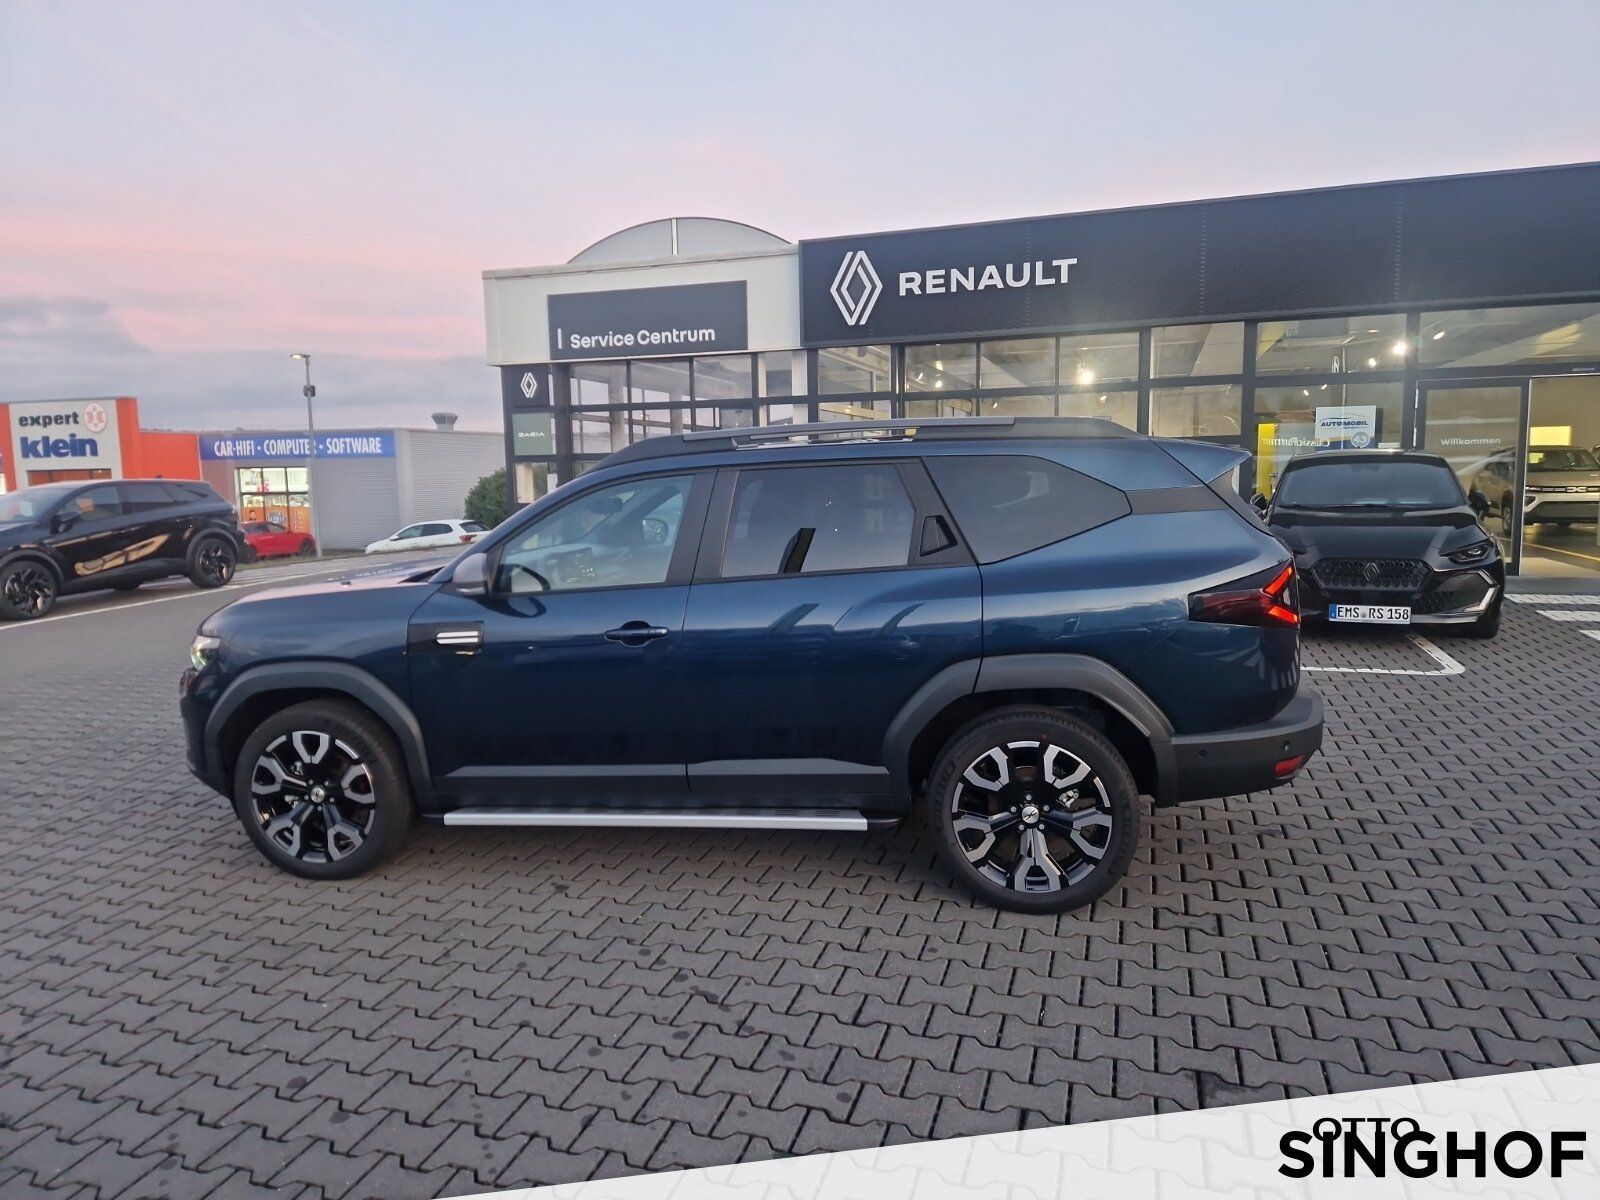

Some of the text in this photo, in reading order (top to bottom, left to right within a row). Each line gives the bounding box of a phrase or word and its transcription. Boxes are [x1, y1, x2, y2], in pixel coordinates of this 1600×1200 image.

[899, 258, 1078, 296] RENAULT
[570, 328, 715, 349] Service Centrum
[18, 411, 79, 428] expert
[20, 433, 98, 458] klein
[214, 440, 255, 456] CAR-HIFI
[326, 437, 382, 454] SOFTWARE
[1440, 437, 1501, 446] Willkommen
[1337, 606, 1409, 620] EMS RS 158
